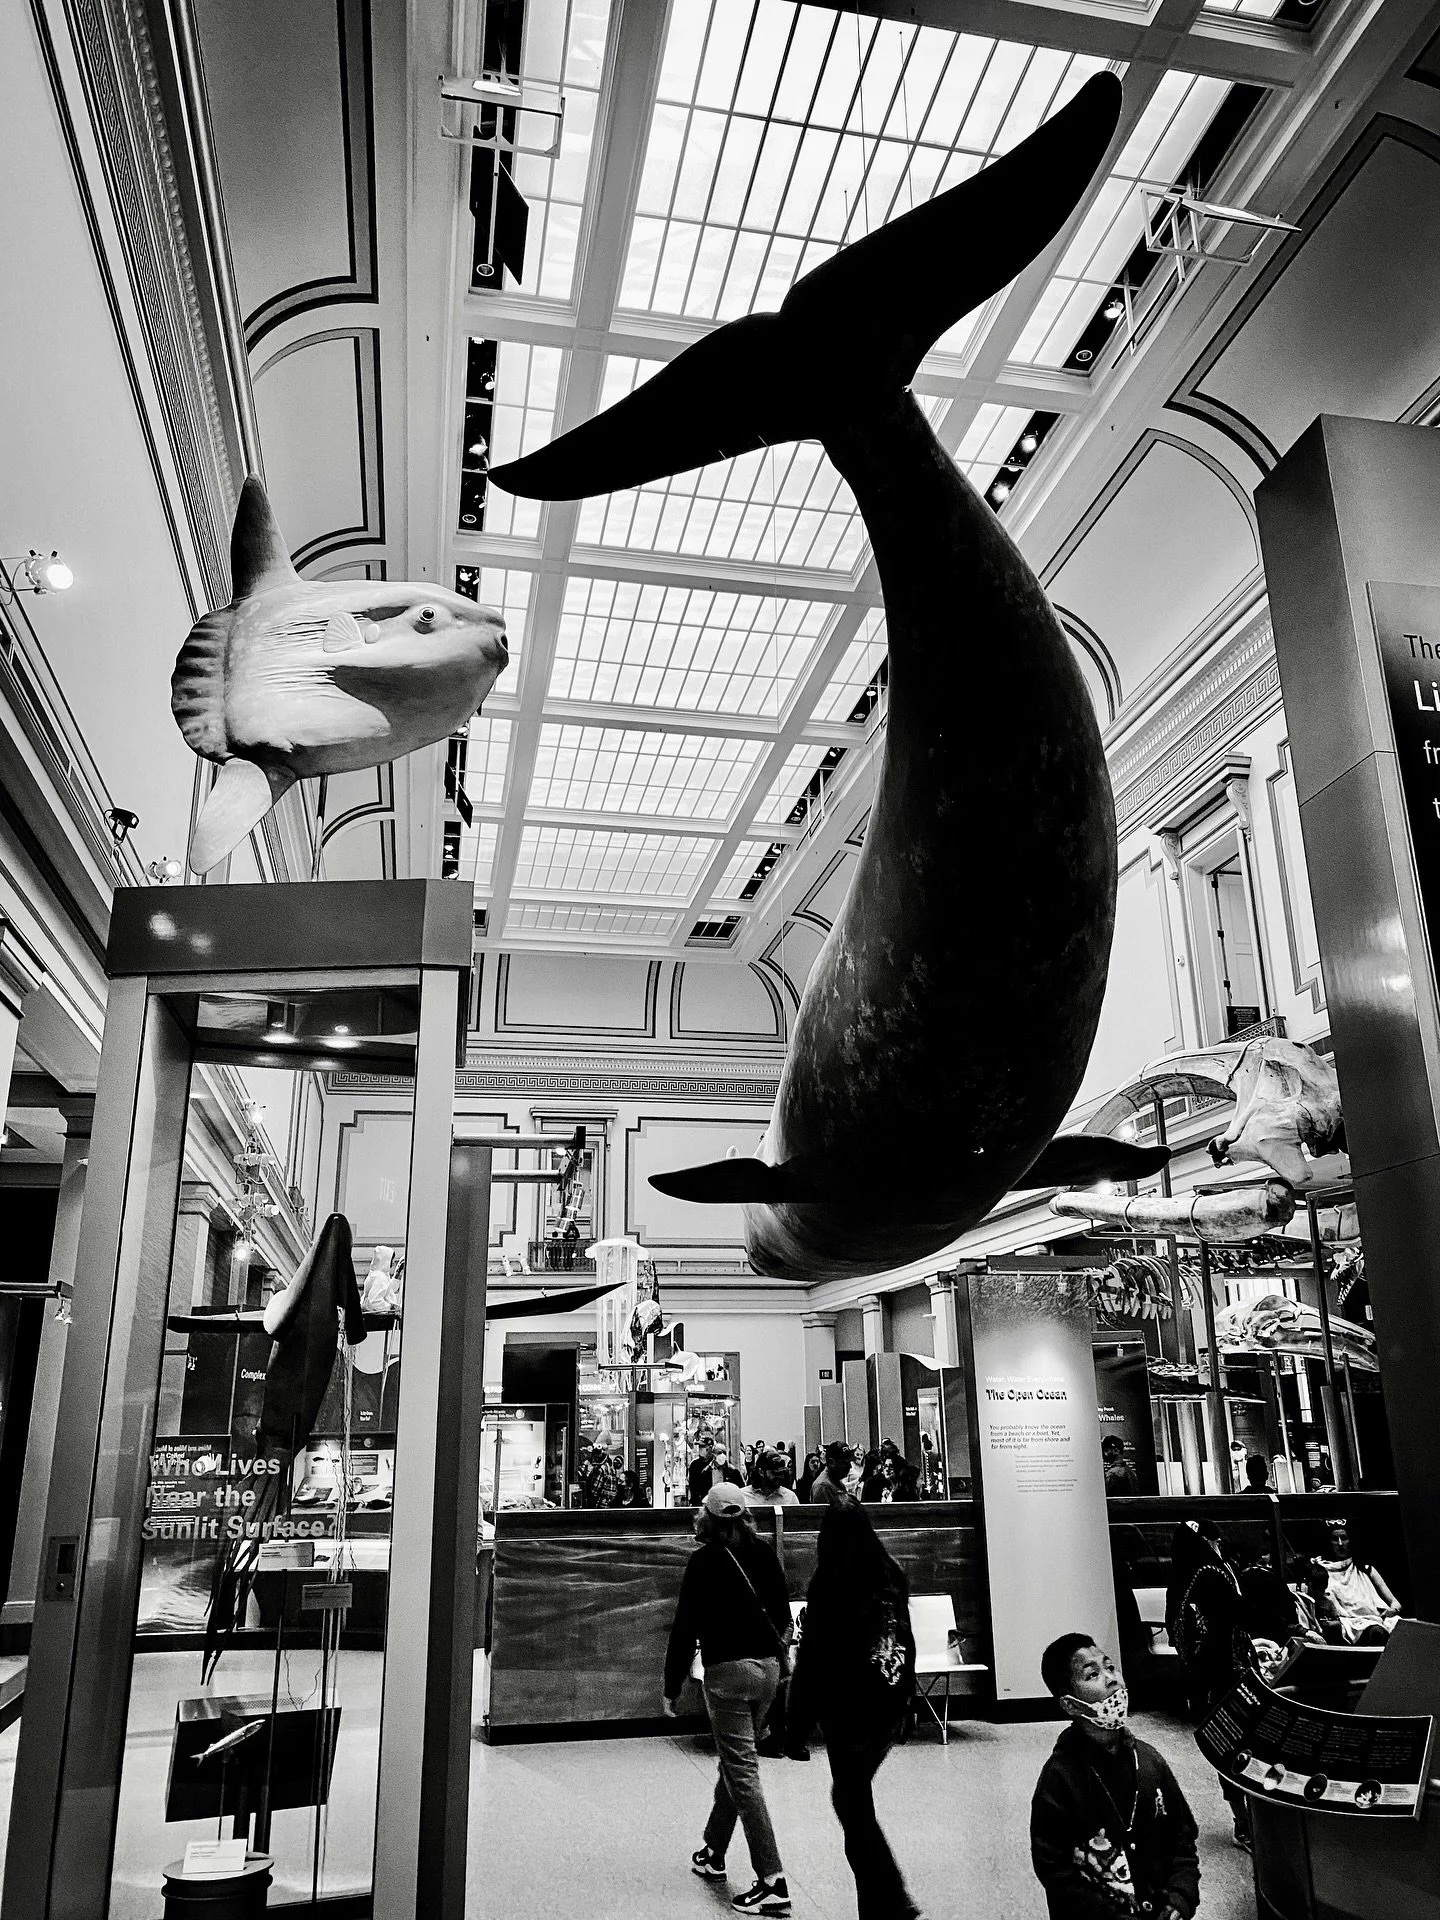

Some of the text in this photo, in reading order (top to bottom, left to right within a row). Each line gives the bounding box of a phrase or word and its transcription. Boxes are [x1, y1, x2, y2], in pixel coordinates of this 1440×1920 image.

[240, 1368, 267, 1382] Complex
[985, 1388, 1068, 1402] The Open Ocean
[149, 1455, 205, 1476] Who
[214, 1453, 281, 1476] Lives
[145, 1486, 207, 1508] Near
[213, 1484, 256, 1507] the
[141, 1516, 218, 1540] Sunlit
